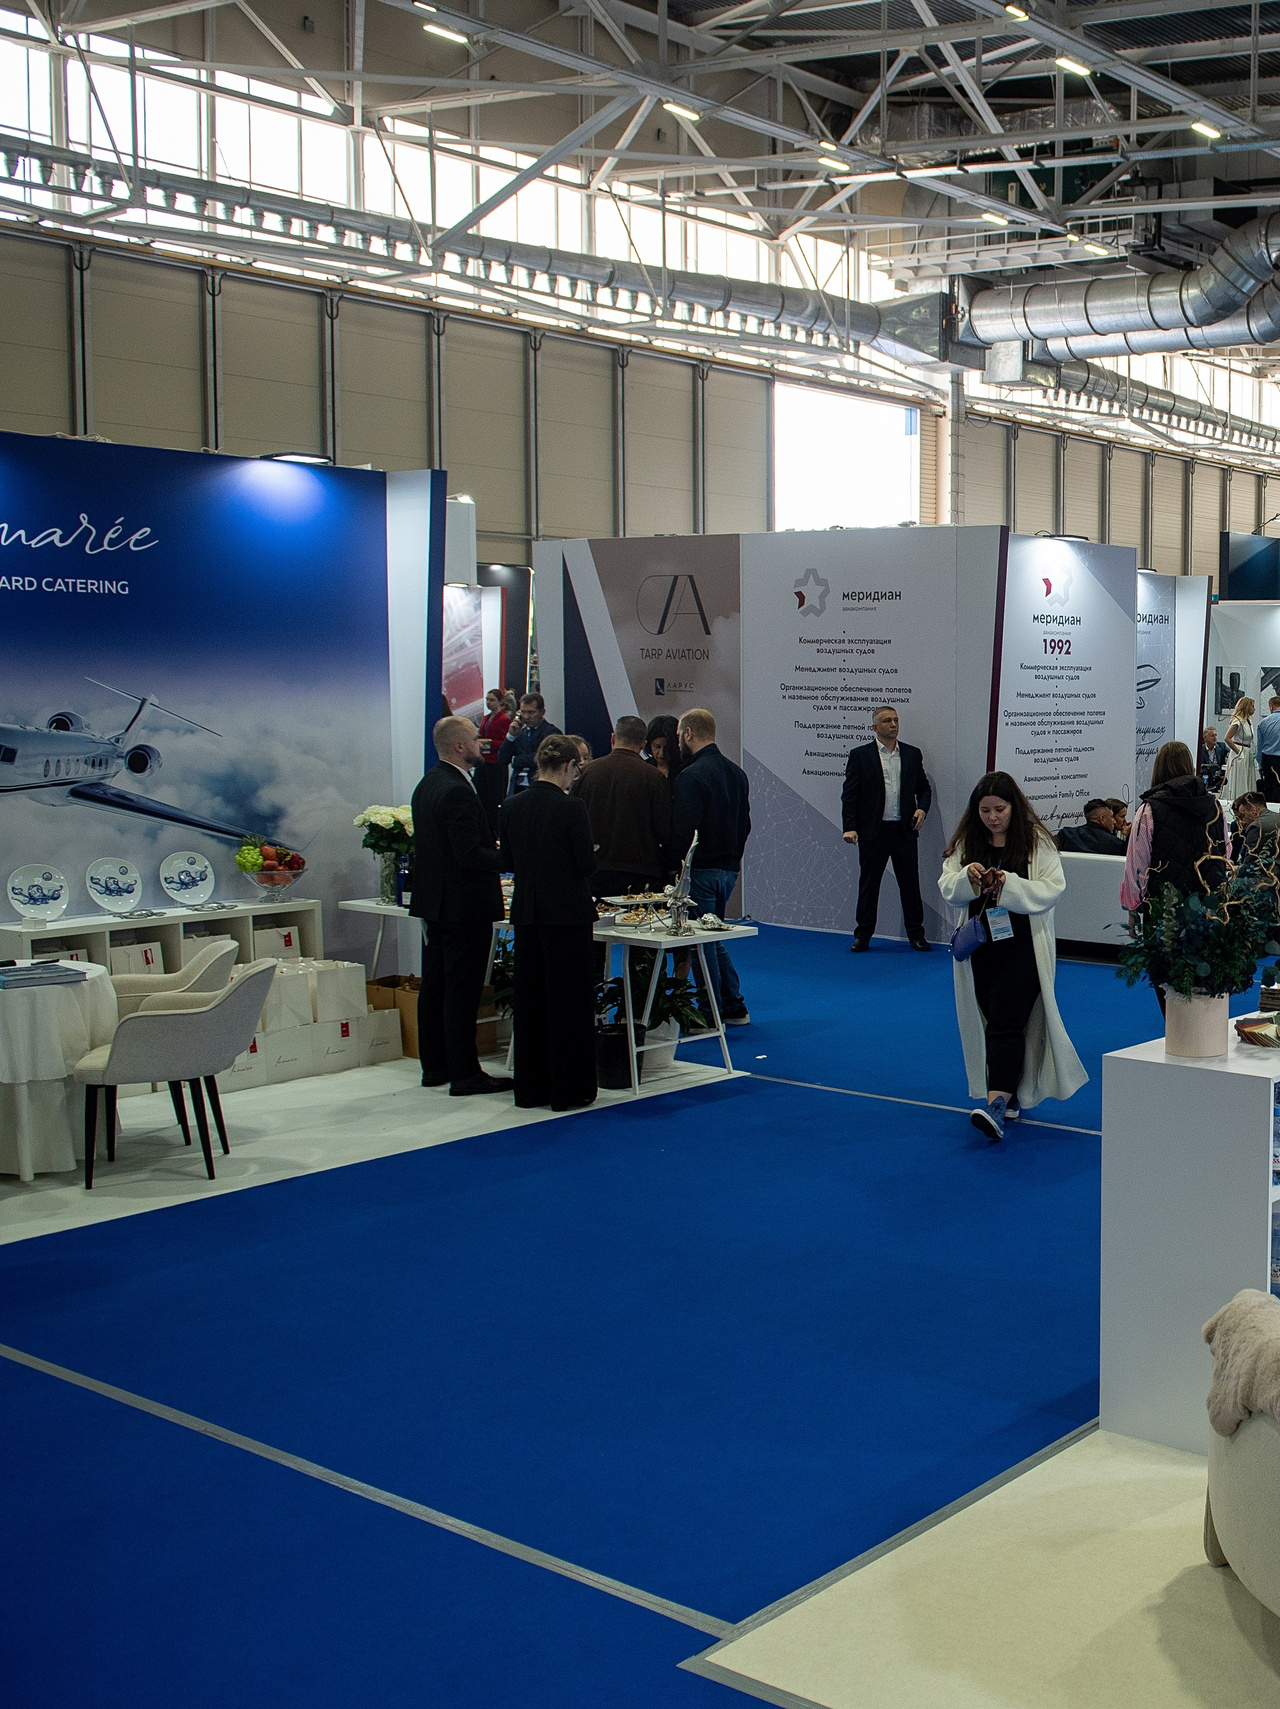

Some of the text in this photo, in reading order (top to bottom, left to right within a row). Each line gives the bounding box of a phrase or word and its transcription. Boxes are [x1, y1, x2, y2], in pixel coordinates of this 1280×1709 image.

[42, 577, 129, 594] CATERING
[842, 590, 902, 602] меридиан
[1032, 613, 1081, 627] меридиан
[798, 637, 892, 647] Коммерческая эксплуатация
[1042, 638, 1072, 655] 1992
[639, 648, 710, 660] TARP AVIATION
[816, 648, 875, 656] воздушных судов
[794, 665, 898, 676] Менеджмент воздушных судов
[1019, 662, 1092, 673] Коммерческая эксплуатация
[1034, 674, 1064, 682] воздушных
[780, 683, 838, 692] Организационное
[840, 684, 883, 693] обеспечение
[820, 693, 869, 703] обслуживание
[871, 696, 910, 704] воздушных
[1016, 691, 1051, 699] Менеджмент
[1052, 692, 1080, 700] воздушных
[812, 704, 831, 712] судов
[1003, 710, 1051, 719] Организационное
[1053, 709, 1085, 717] обеспечение
[794, 721, 841, 731] Поддержание
[842, 723, 866, 731] летной
[1037, 718, 1075, 727] обслуживание
[1076, 719, 1104, 727] воздушных
[816, 733, 854, 741] воздушных
[1052, 728, 1082, 736] пассажиров
[804, 749, 850, 759] Авиационный
[1015, 747, 1053, 756] Поддержание
[1054, 746, 1072, 754] летной
[1023, 773, 1088, 783] Авиационный консалтинг
[1058, 790, 1074, 799] Family
[1075, 789, 1090, 797] Office
